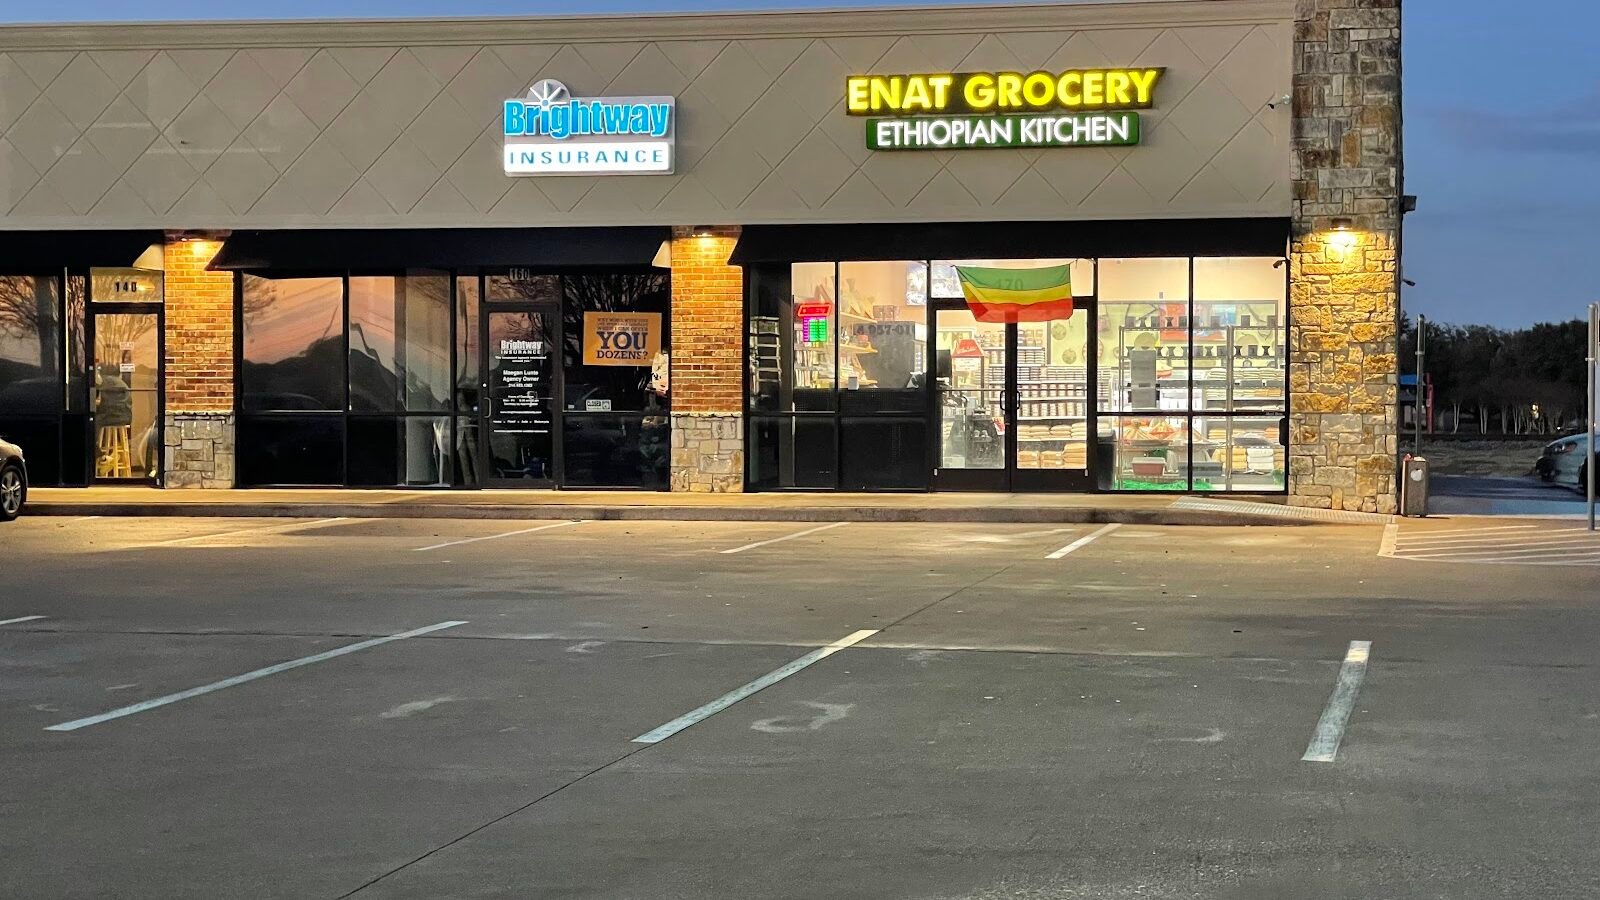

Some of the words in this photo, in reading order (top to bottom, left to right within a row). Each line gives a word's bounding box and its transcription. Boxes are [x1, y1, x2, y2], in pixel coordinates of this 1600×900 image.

[848, 76, 952, 110] ENAT
[963, 71, 1158, 108] GROCERY
[503, 99, 669, 139] Brightway
[876, 118, 1012, 146] ETHIOPIAN
[1020, 115, 1129, 143] KITCHEN
[509, 149, 664, 165] INSURANCE
[115, 281, 137, 293] 140
[501, 340, 544, 351] Brightway
[597, 331, 649, 350] YOU
[596, 350, 649, 360] DOZENS?
